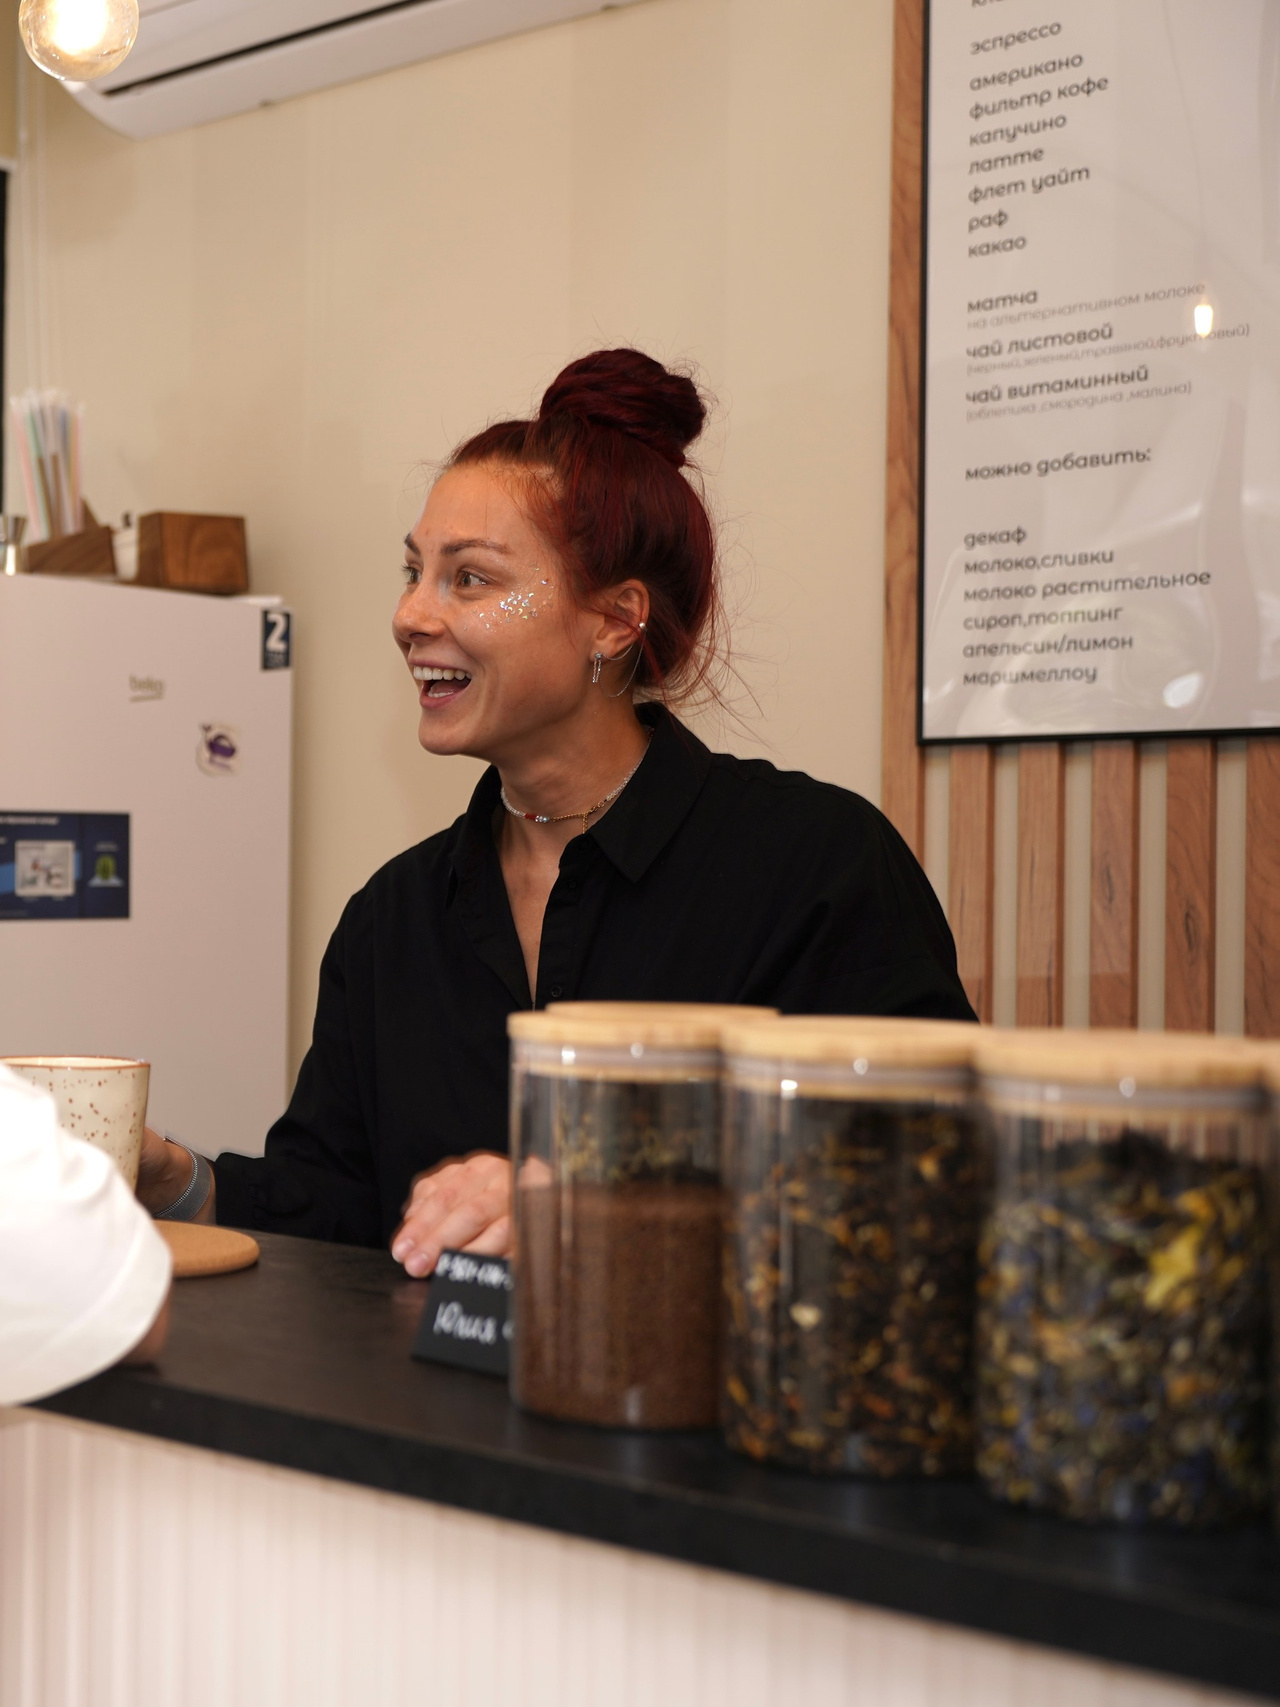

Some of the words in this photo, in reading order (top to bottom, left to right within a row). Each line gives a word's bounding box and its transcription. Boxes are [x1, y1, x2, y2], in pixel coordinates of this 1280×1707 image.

[970, 22, 1061, 55] эспрессо
[969, 54, 1083, 91] американо
[969, 89, 1051, 120] фильтр
[1057, 75, 1109, 101] кофе
[969, 113, 1067, 147] капучино
[969, 147, 1044, 175] латте
[968, 178, 1026, 204] флет
[1032, 165, 1090, 194] уайт
[968, 209, 1009, 233] раф
[968, 235, 1027, 258] какао
[967, 289, 1038, 314] матча
[967, 315, 987, 330] на
[990, 294, 1140, 328] альтернативном
[1144, 283, 1206, 303] молоке
[966, 339, 1002, 359] чай
[1007, 322, 1114, 355] листовой
[966, 384, 1002, 405] чай
[1007, 364, 1149, 400] витаминный
[966, 457, 1032, 482] можно
[1037, 447, 1151, 477] добавить:
[964, 526, 1027, 548] декаф
[964, 549, 1114, 575] молоко,сливки
[964, 582, 1036, 602] молоко
[1041, 570, 1211, 600] растительное
[266, 612, 288, 652] 2
[963, 606, 1123, 632] сироп,топпинг
[963, 633, 1133, 660] апельсин/лимон
[963, 664, 1097, 688] маршмеллоу
